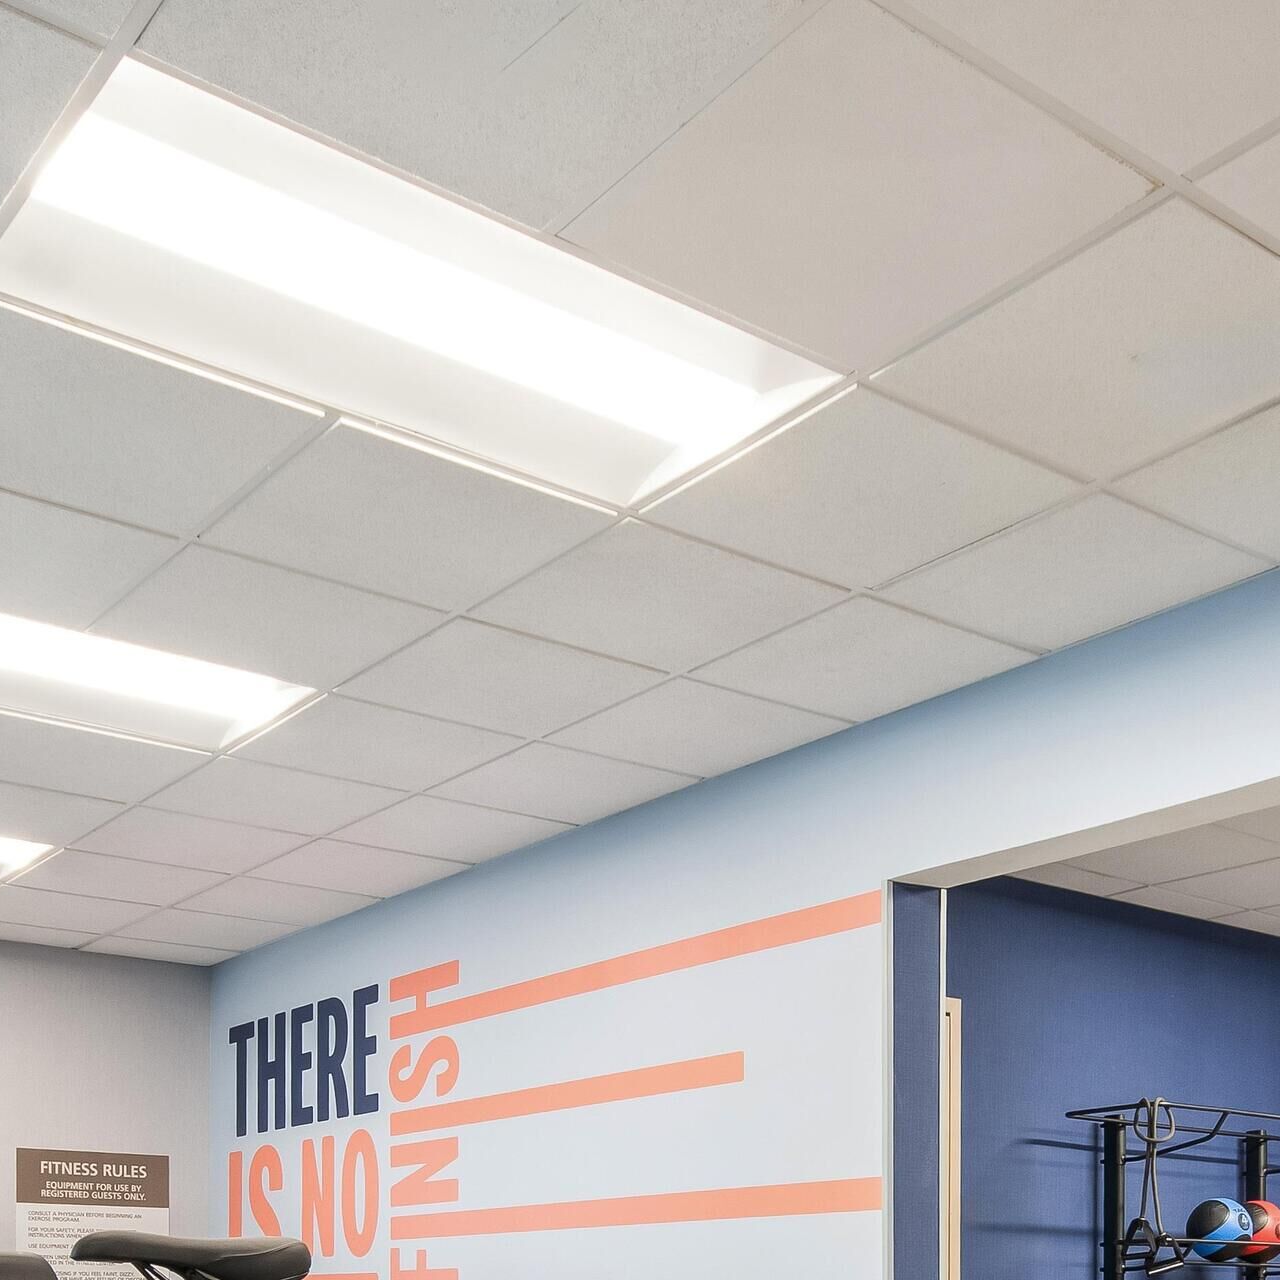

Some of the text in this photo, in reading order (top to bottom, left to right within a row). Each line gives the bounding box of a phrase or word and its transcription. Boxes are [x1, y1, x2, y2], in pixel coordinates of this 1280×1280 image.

[228, 983, 379, 1137] THERE
[40, 1161, 147, 1178] FITNESS RULES
[40, 1189, 147, 1201] REGISTERED GUESTS ONLY.
[46, 1181, 94, 1191] EQUIPMENT
[114, 1184, 129, 1192] USE
[300, 1128, 379, 1258] NO
